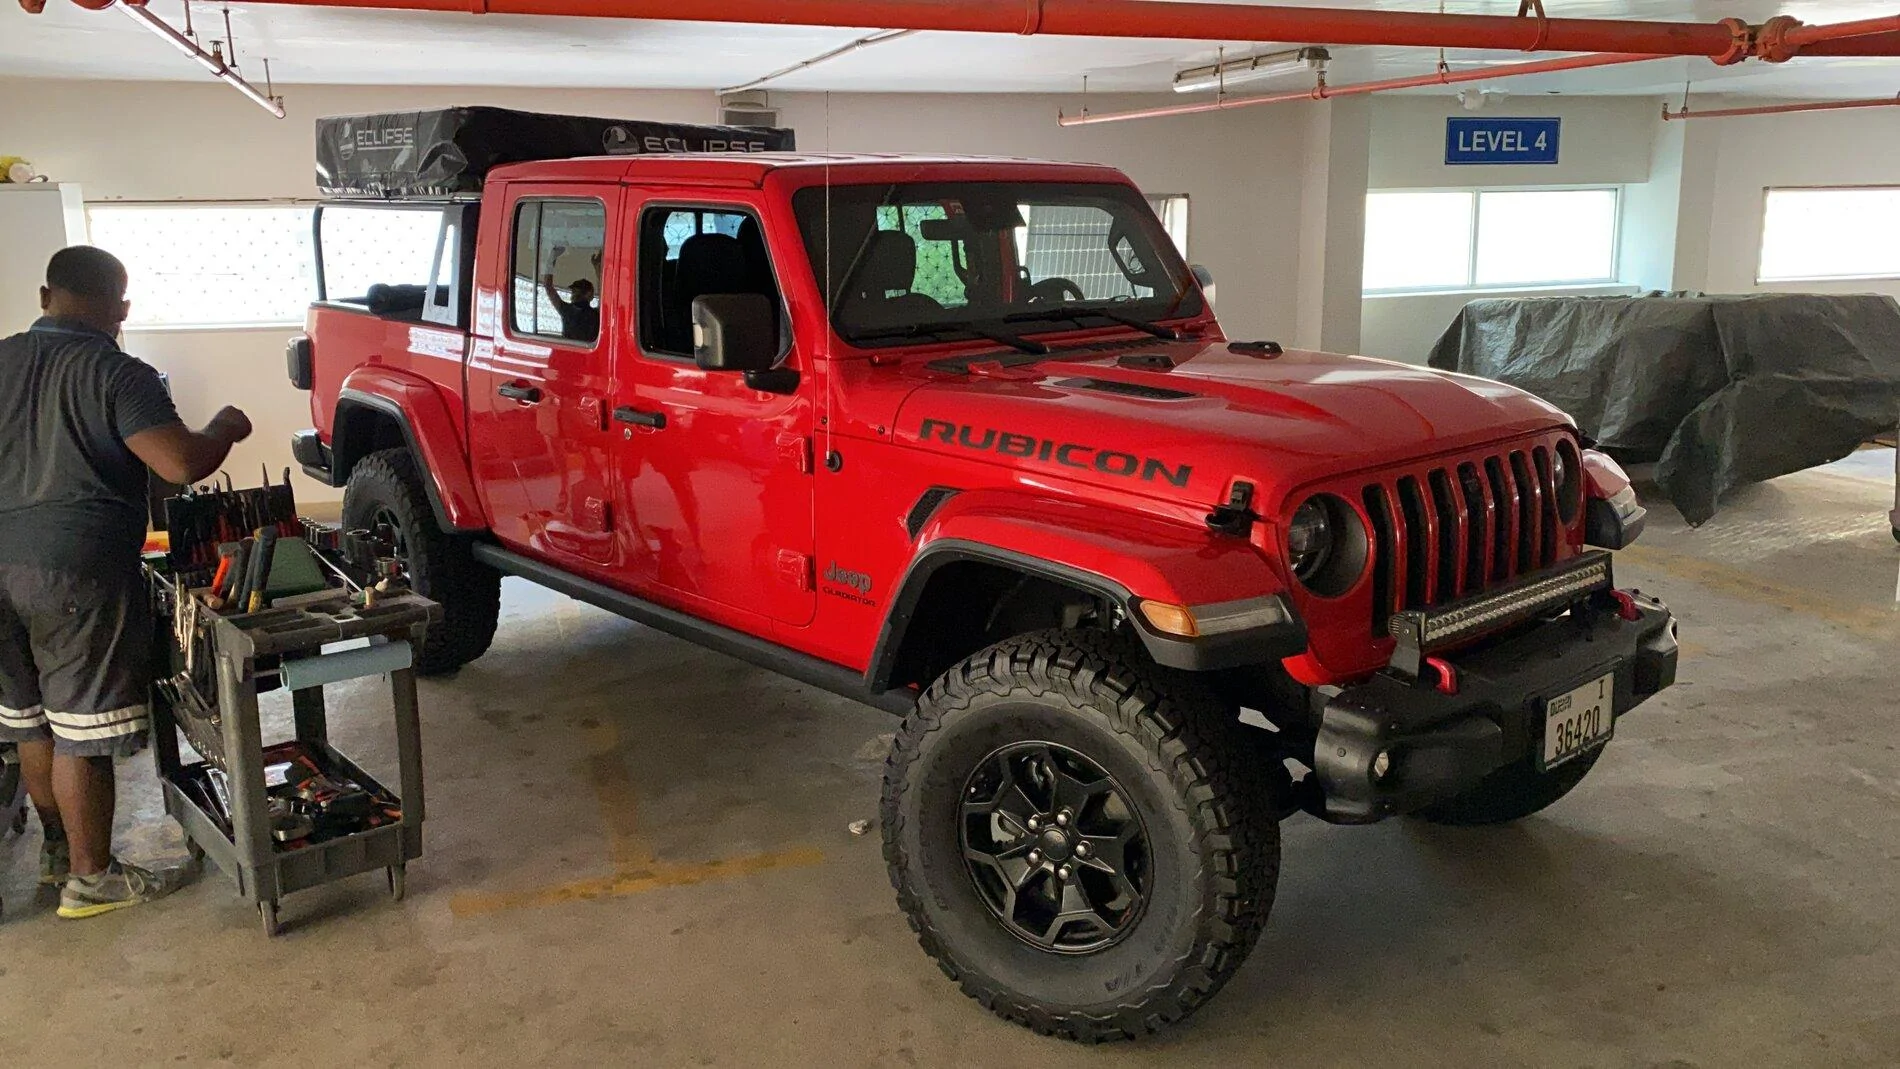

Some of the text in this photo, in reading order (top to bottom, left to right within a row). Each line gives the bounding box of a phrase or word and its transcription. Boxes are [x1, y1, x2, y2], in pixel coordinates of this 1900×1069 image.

[1458, 130, 1547, 152] LEVEL 4
[919, 418, 1193, 488] RUBICON
[823, 559, 872, 595] Jeep
[1555, 705, 1600, 755] 36420
